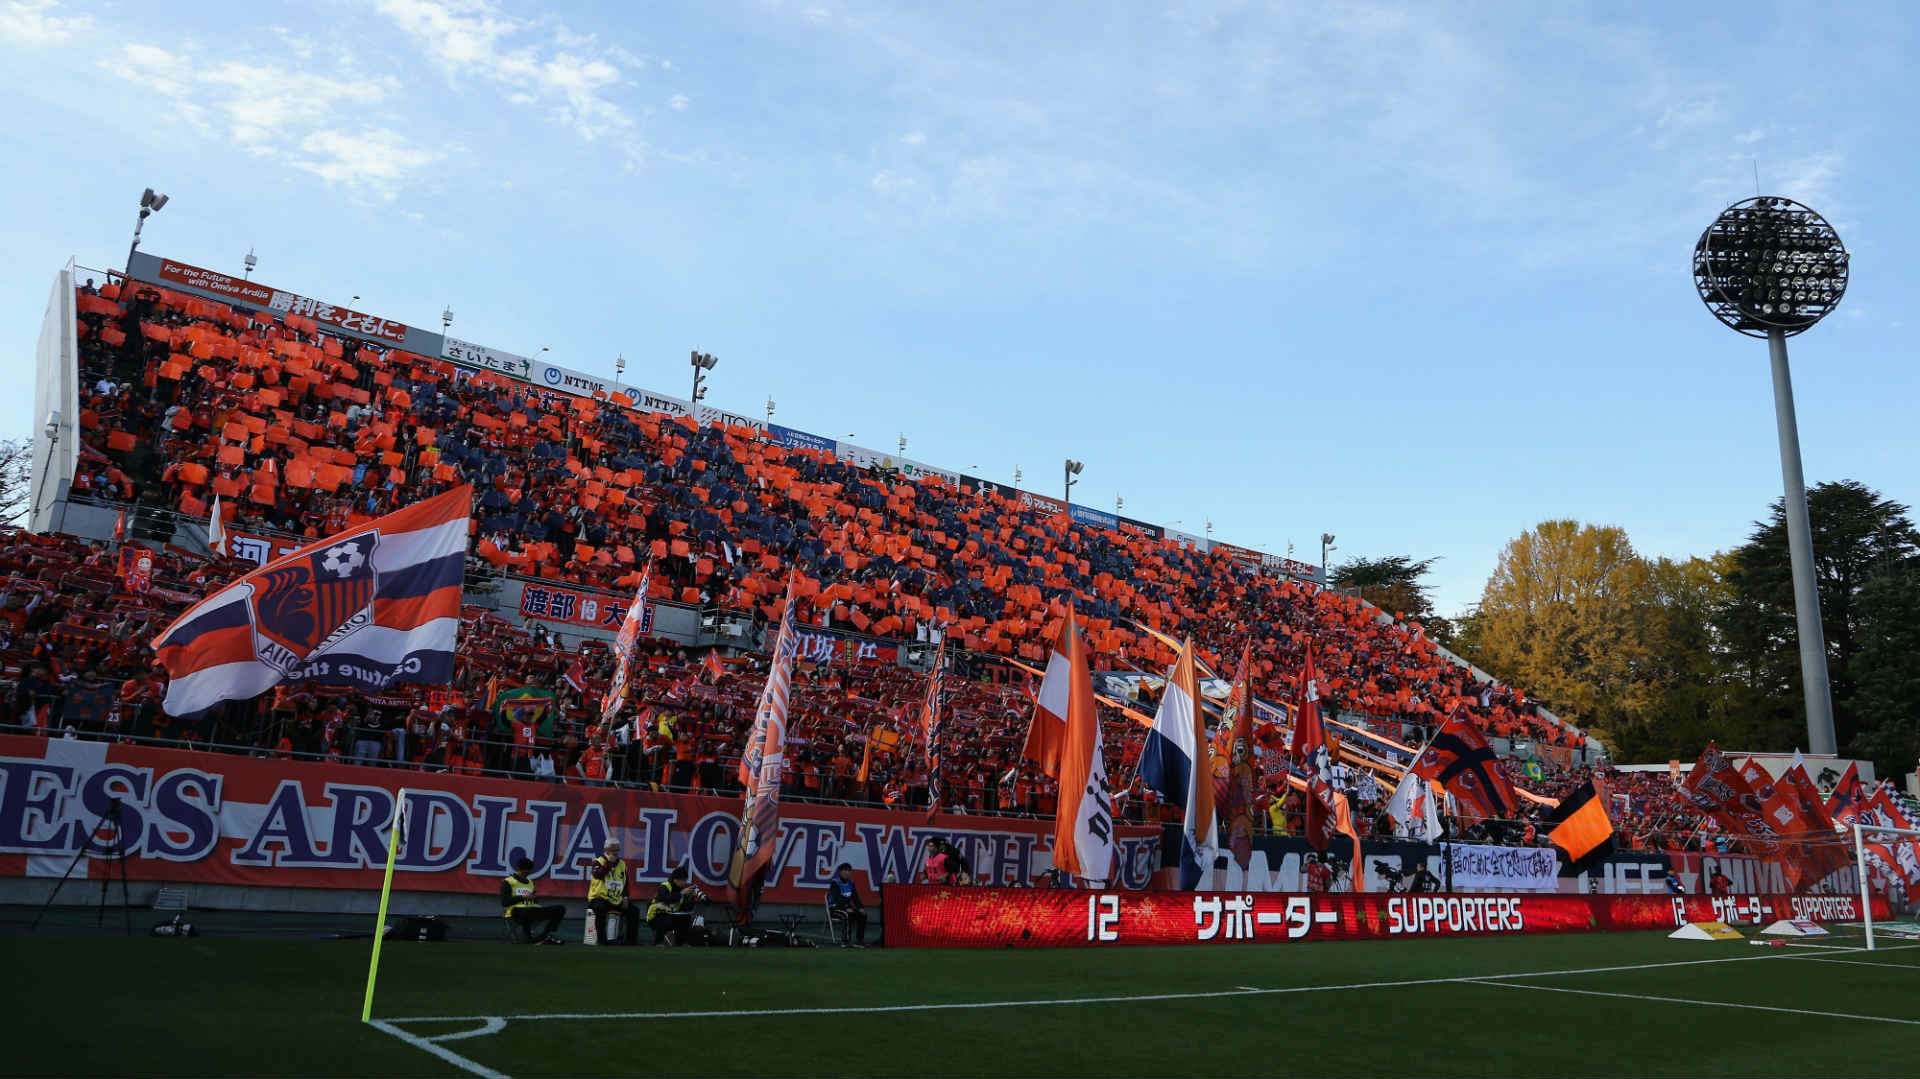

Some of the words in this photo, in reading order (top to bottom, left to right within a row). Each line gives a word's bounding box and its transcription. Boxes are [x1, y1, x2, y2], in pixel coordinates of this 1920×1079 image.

[164, 263, 182, 274] For
[183, 268, 200, 279] the
[200, 271, 232, 284] Future
[188, 278, 209, 289] with
[210, 281, 240, 294] Omiya
[449, 346, 516, 373] さいたま
[524, 587, 577, 619] 渡部
[230, 779, 620, 884] ARDIJA
[1087, 894, 1119, 941] 12
[1193, 895, 1338, 939] サポーター
[1388, 897, 1524, 934] SUPPORTERS
[1671, 896, 1688, 927] 12
[1791, 896, 1856, 923] SUPPORTERS
